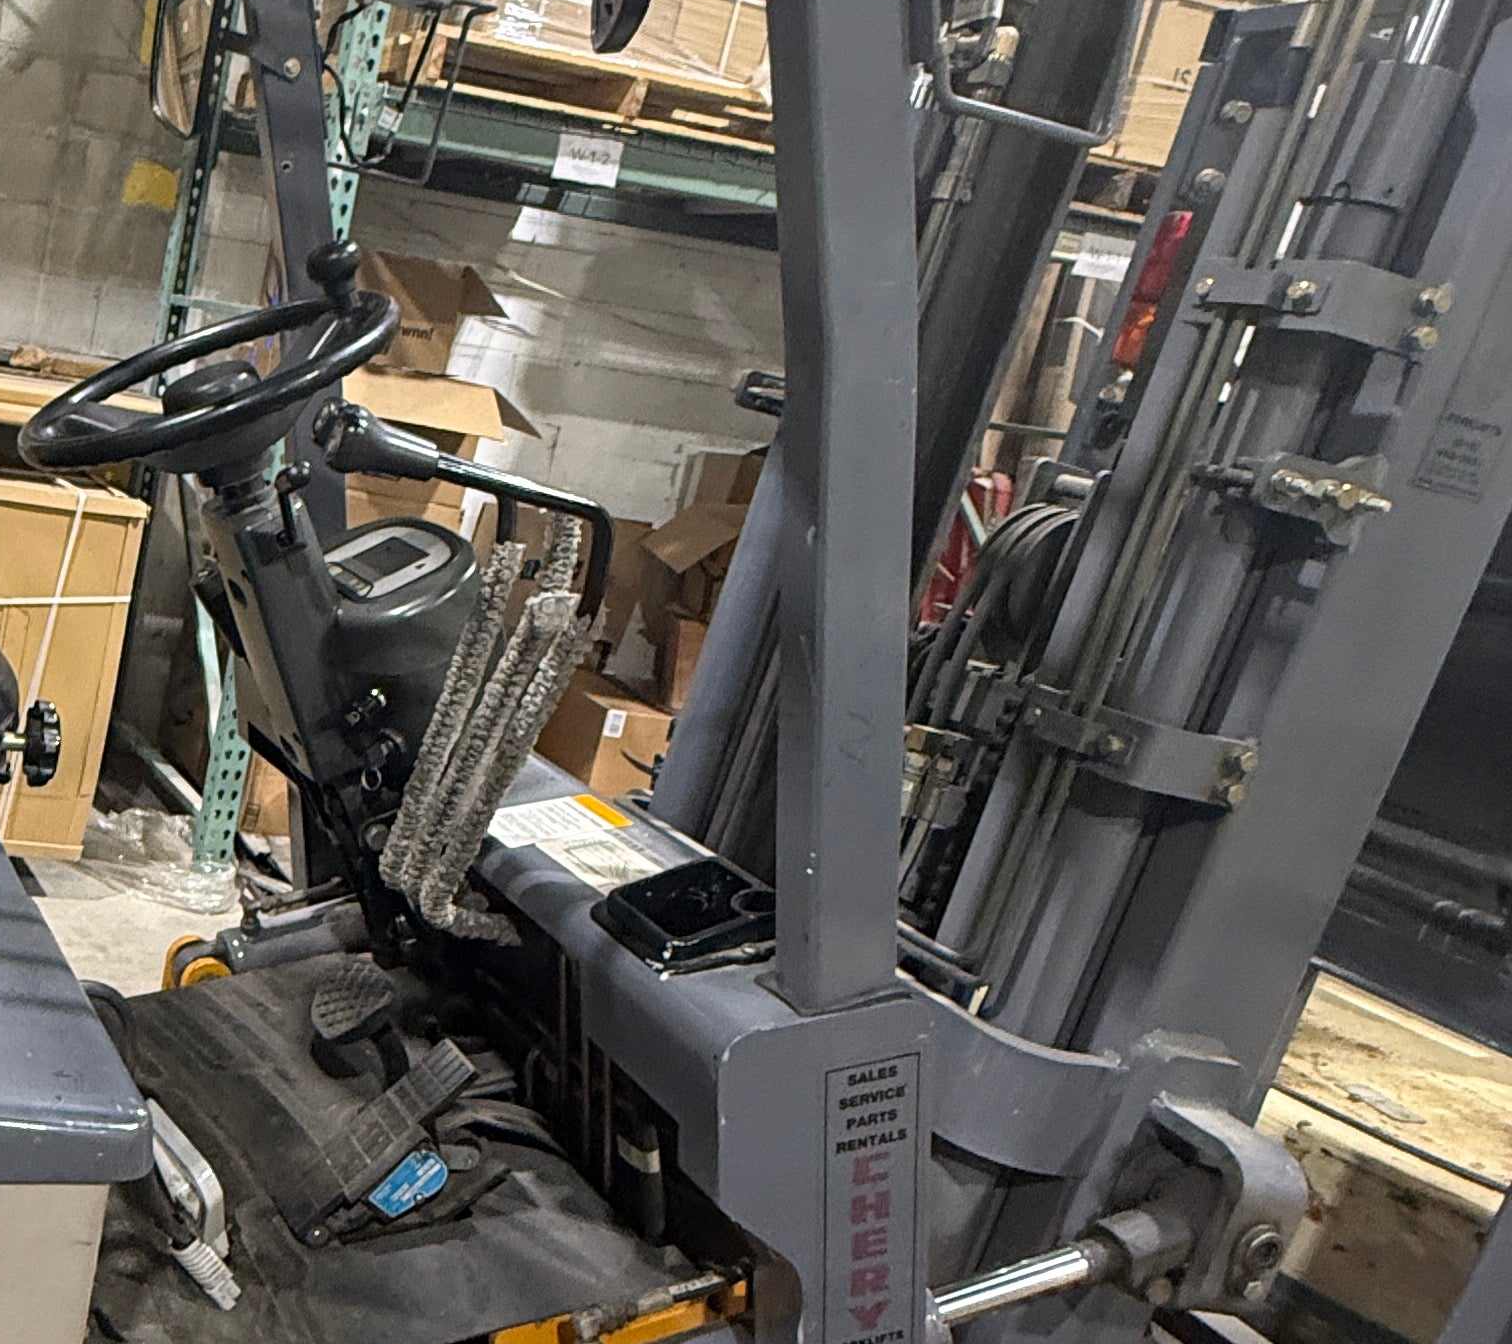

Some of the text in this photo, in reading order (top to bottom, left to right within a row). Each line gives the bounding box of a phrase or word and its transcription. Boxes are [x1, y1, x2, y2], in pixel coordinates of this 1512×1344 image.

[847, 1065, 899, 1087] SALES
[838, 1083, 907, 1111] SERVICE
[846, 1109, 898, 1131] PARTS
[835, 1128, 908, 1154] RENTALS
[848, 1151, 891, 1331] CHERY
